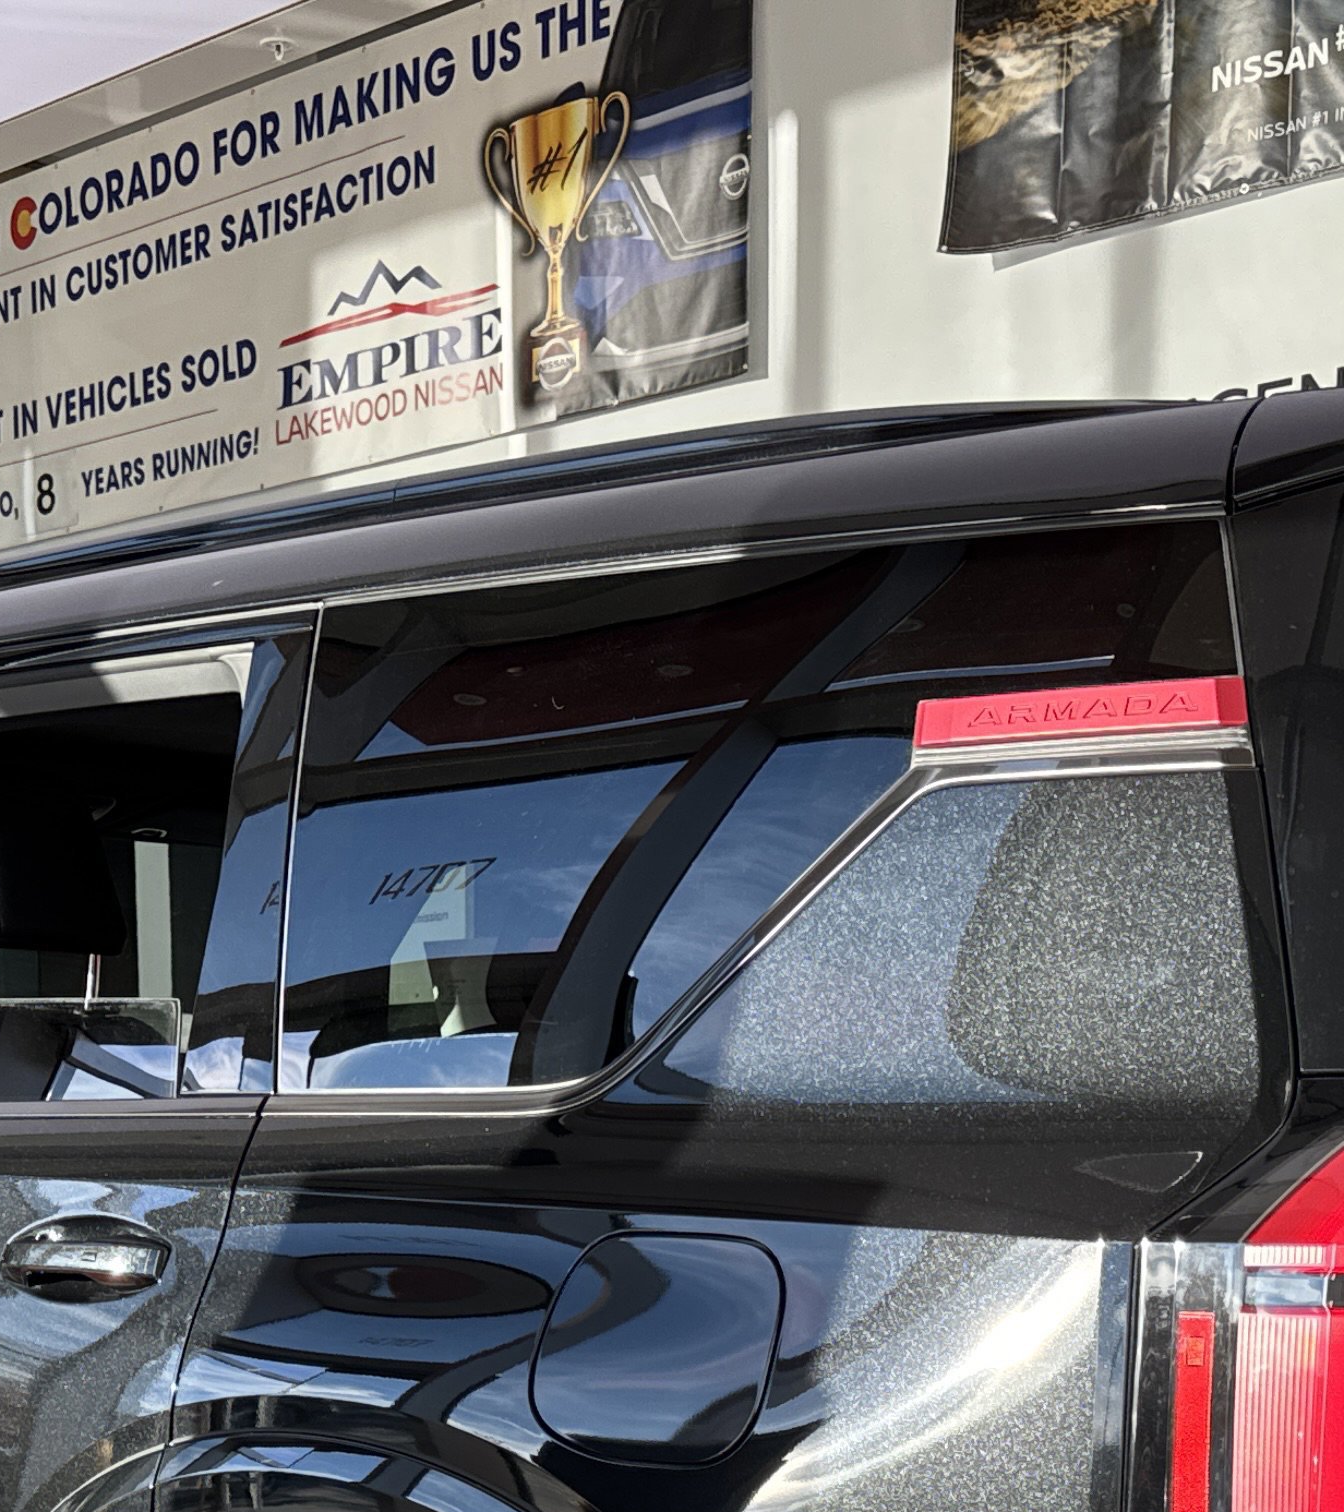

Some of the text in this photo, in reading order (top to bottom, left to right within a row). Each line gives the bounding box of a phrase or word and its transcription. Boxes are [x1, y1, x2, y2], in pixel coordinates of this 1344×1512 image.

[1211, 37, 1329, 93] NISSAN
[10, 141, 200, 250] COLORADO
[212, 110, 280, 175] FOR
[293, 47, 456, 145] MAKING
[471, 21, 522, 82] US
[535, 0, 612, 58] THE
[527, 127, 588, 195] #1
[1247, 116, 1306, 143] NISSAN
[1312, 110, 1329, 128] #1
[31, 274, 56, 314] IN
[66, 223, 210, 302] CUSTOMER
[220, 145, 436, 253] SATISFACTION
[12, 399, 38, 440] IN
[46, 361, 172, 429] VEHICLES
[180, 337, 257, 393] SOLD
[276, 306, 504, 411] EMPIRE
[275, 363, 504, 446] LAKEWOOD NISSAN
[36, 473, 56, 515] 8
[81, 456, 145, 497] YEARS
[152, 427, 260, 482] RUNNING!
[968, 691, 1199, 728] ARMADA
